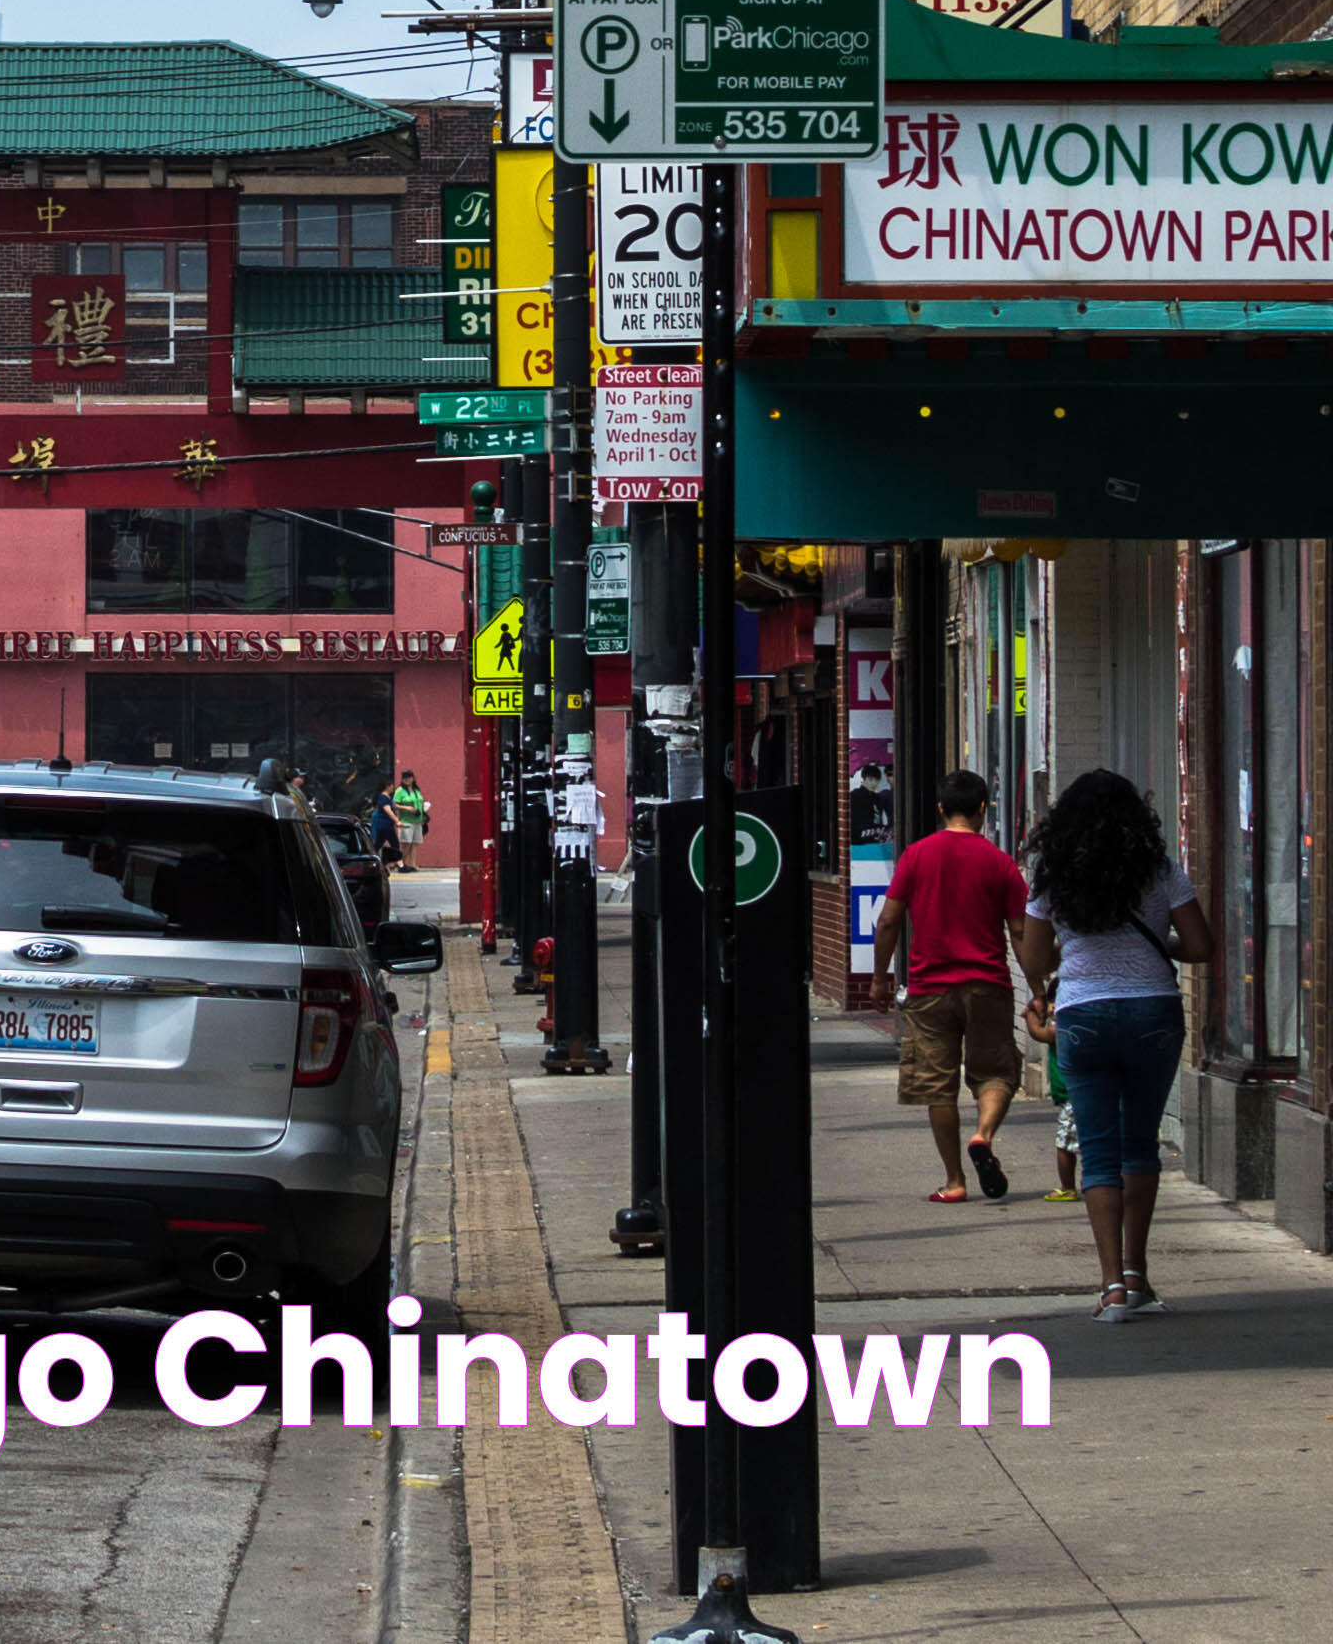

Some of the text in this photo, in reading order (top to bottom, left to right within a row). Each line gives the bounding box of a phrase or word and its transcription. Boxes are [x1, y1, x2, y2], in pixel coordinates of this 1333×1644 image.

[650, 37, 674, 50] OR
[713, 25, 869, 55] ParkChicago
[836, 54, 869, 66] .com
[717, 76, 847, 89] FOR MOBILE PAY
[678, 110, 861, 140] ZONE 535 704
[877, 112, 1333, 190] 球 WON KOW
[620, 165, 704, 194] LIMIT
[613, 201, 704, 263] 20
[878, 206, 1202, 263] CHINATOWN
[607, 270, 704, 289] ON SCHOOL DA
[612, 291, 702, 310] WHEN CHILDR
[621, 312, 703, 331] ARE PRESEN
[604, 366, 702, 384] Street Clean
[430, 396, 533, 419] W 22ND PL
[605, 390, 693, 409] No Parking
[605, 409, 638, 424] 7am
[652, 409, 686, 424] 9am
[605, 427, 697, 447] Wednesday
[606, 446, 645, 466] April
[648, 447, 655, 462] 1
[669, 447, 697, 462] Oct
[605, 477, 700, 499] Tow Zon
[438, 531, 497, 543] CONFUCIUS
[90, 630, 284, 662] HAPPINESS
[296, 629, 466, 662] RESTAURA
[483, 690, 523, 710] AHE
[26, 941, 67, 960] Ford
[27, 997, 74, 1010] Illinois
[45, 1012, 94, 1043] 7885
